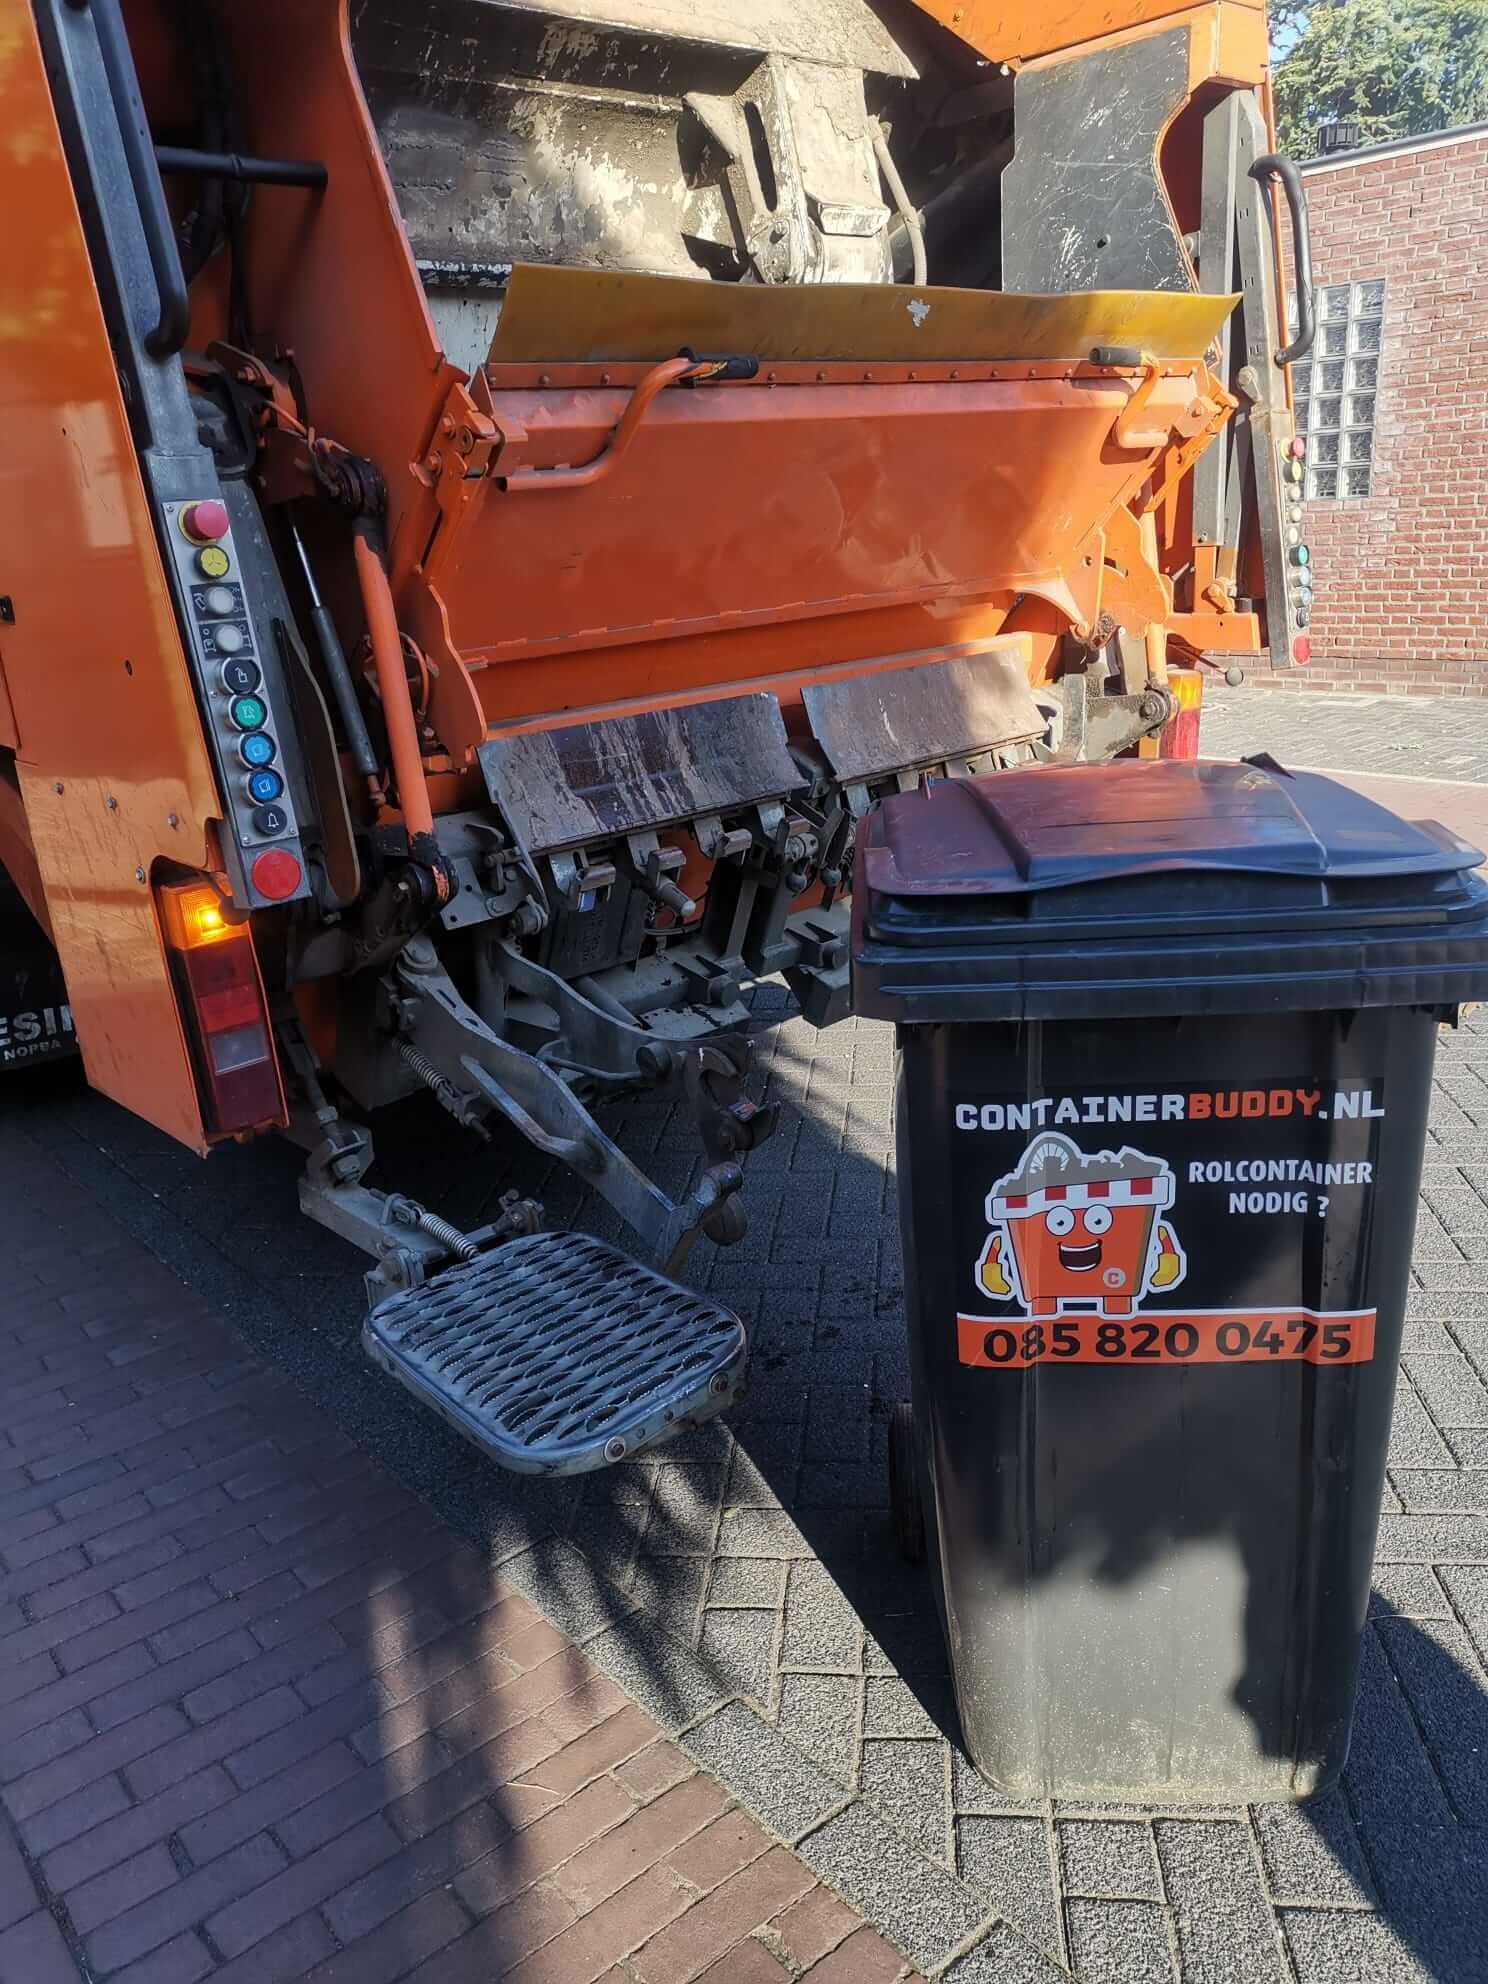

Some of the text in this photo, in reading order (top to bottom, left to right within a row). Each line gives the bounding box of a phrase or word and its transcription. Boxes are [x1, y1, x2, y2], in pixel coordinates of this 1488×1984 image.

[955, 1089, 1385, 1131] CONTAINERBUDDY.NL
[1188, 1159, 1373, 1185] ROLCONTAINER
[1229, 1192, 1330, 1218] NODIG ?
[983, 1320, 1351, 1362] 085 820 0475
